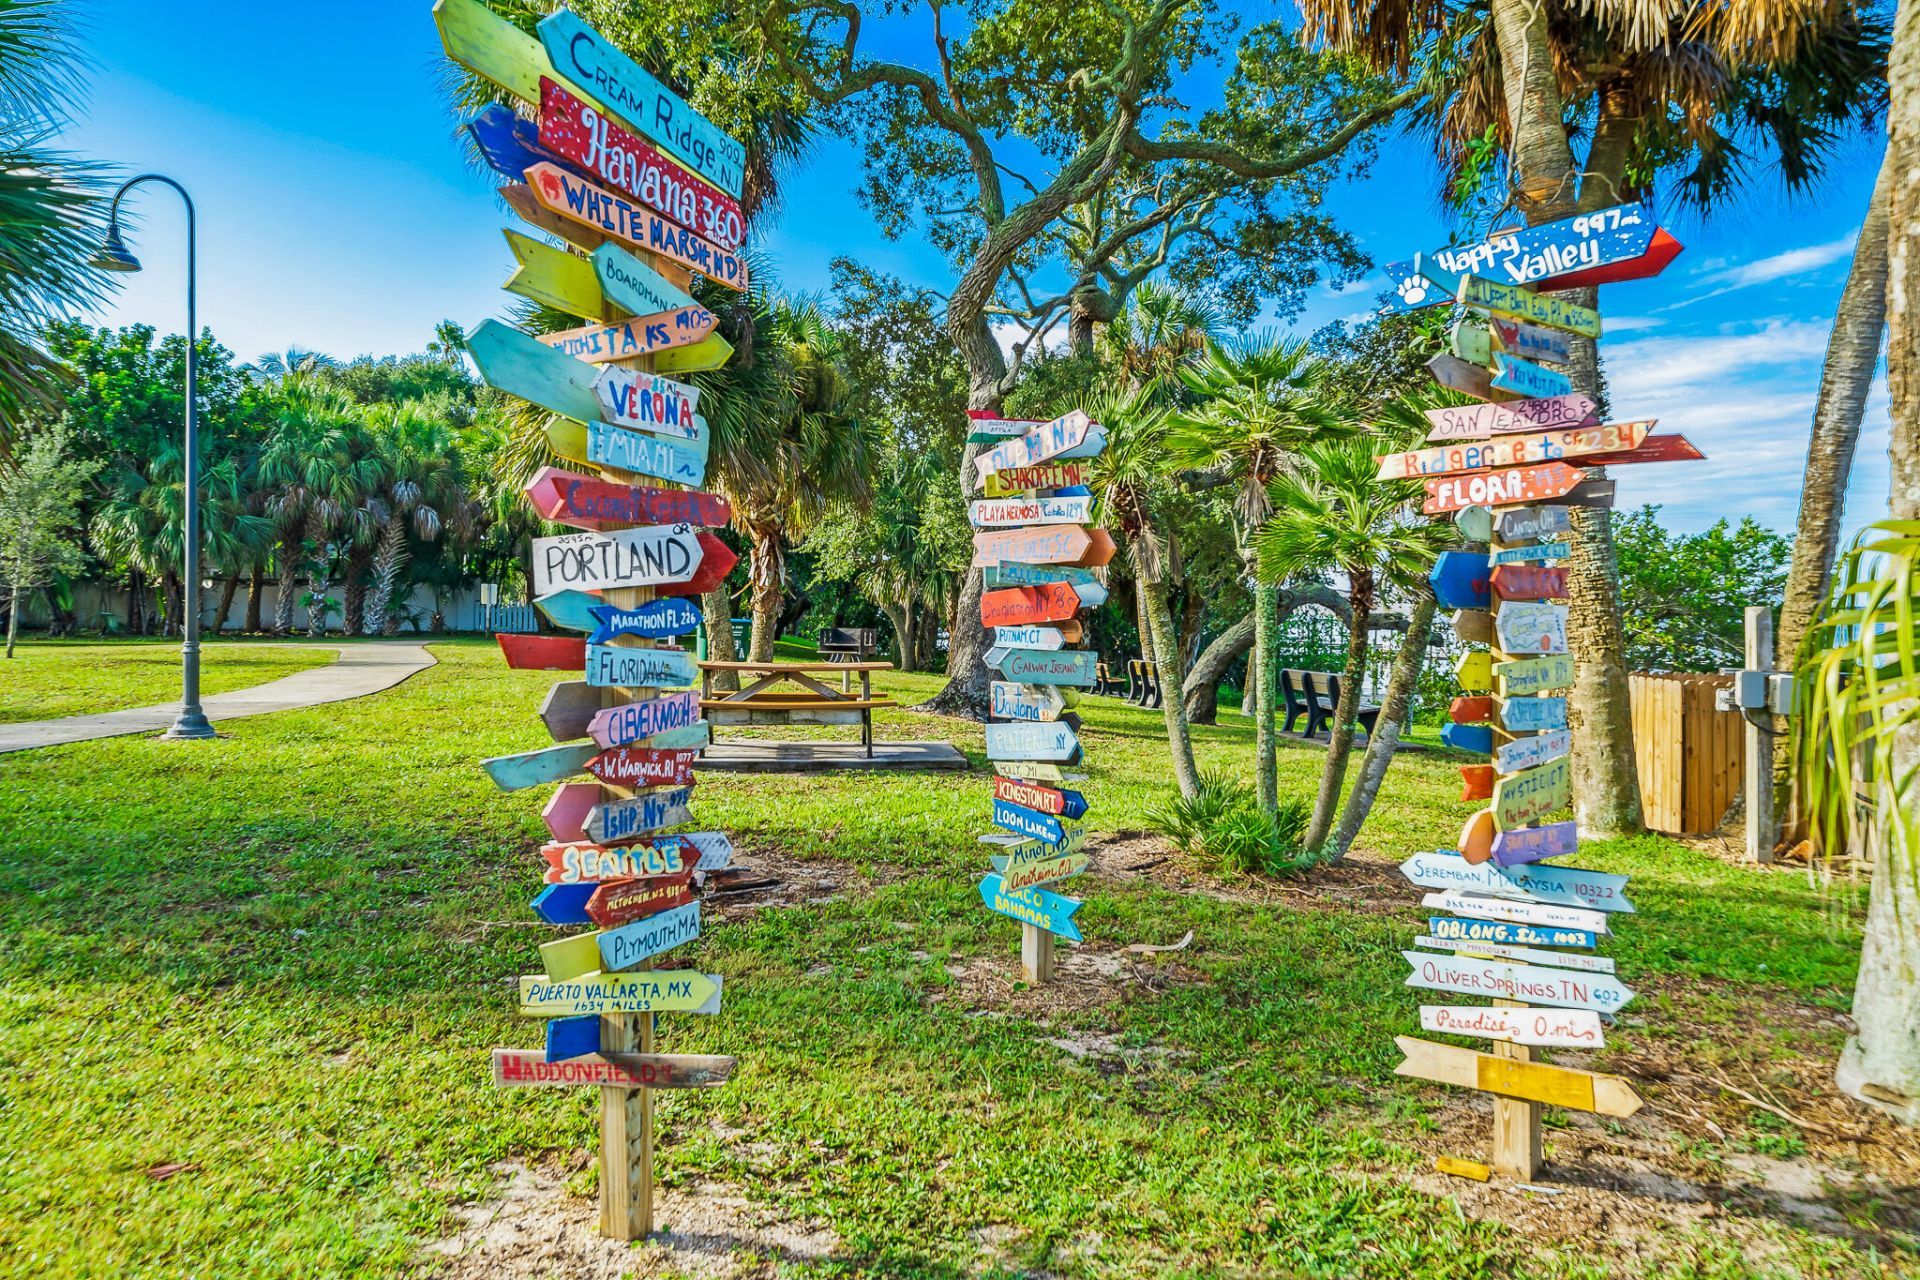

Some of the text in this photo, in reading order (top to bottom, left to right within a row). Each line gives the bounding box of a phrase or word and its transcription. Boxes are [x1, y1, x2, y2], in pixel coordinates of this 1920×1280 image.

[580, 107, 741, 246] Havana 360
[720, 164, 740, 193] NJ
[561, 175, 643, 241] WHITE
[713, 250, 737, 281] MD
[1437, 236, 1600, 283] Happy Valley
[646, 323, 672, 348] KS
[609, 380, 693, 428] VERONA
[1440, 404, 1483, 434] SAN
[607, 432, 674, 476] MIAMI
[979, 504, 1004, 522] PLAYA
[611, 610, 696, 632] MARATHON FL 226
[995, 685, 1040, 721] Daytona
[997, 807, 1024, 830] LOON
[560, 844, 684, 883] SEATTLE
[1488, 868, 1566, 893] MALAYSIA
[1574, 883, 1614, 899] 10322
[677, 914, 698, 938] MA
[995, 894, 1051, 929] BAHAMAS
[527, 984, 582, 1002] PUERTO
[667, 981, 693, 998] MX
[1423, 961, 1480, 989] OLIVER
[1560, 980, 1589, 1003] TN
[611, 1000, 651, 1011] MILES
[501, 1055, 657, 1083] HADDONFIELD
